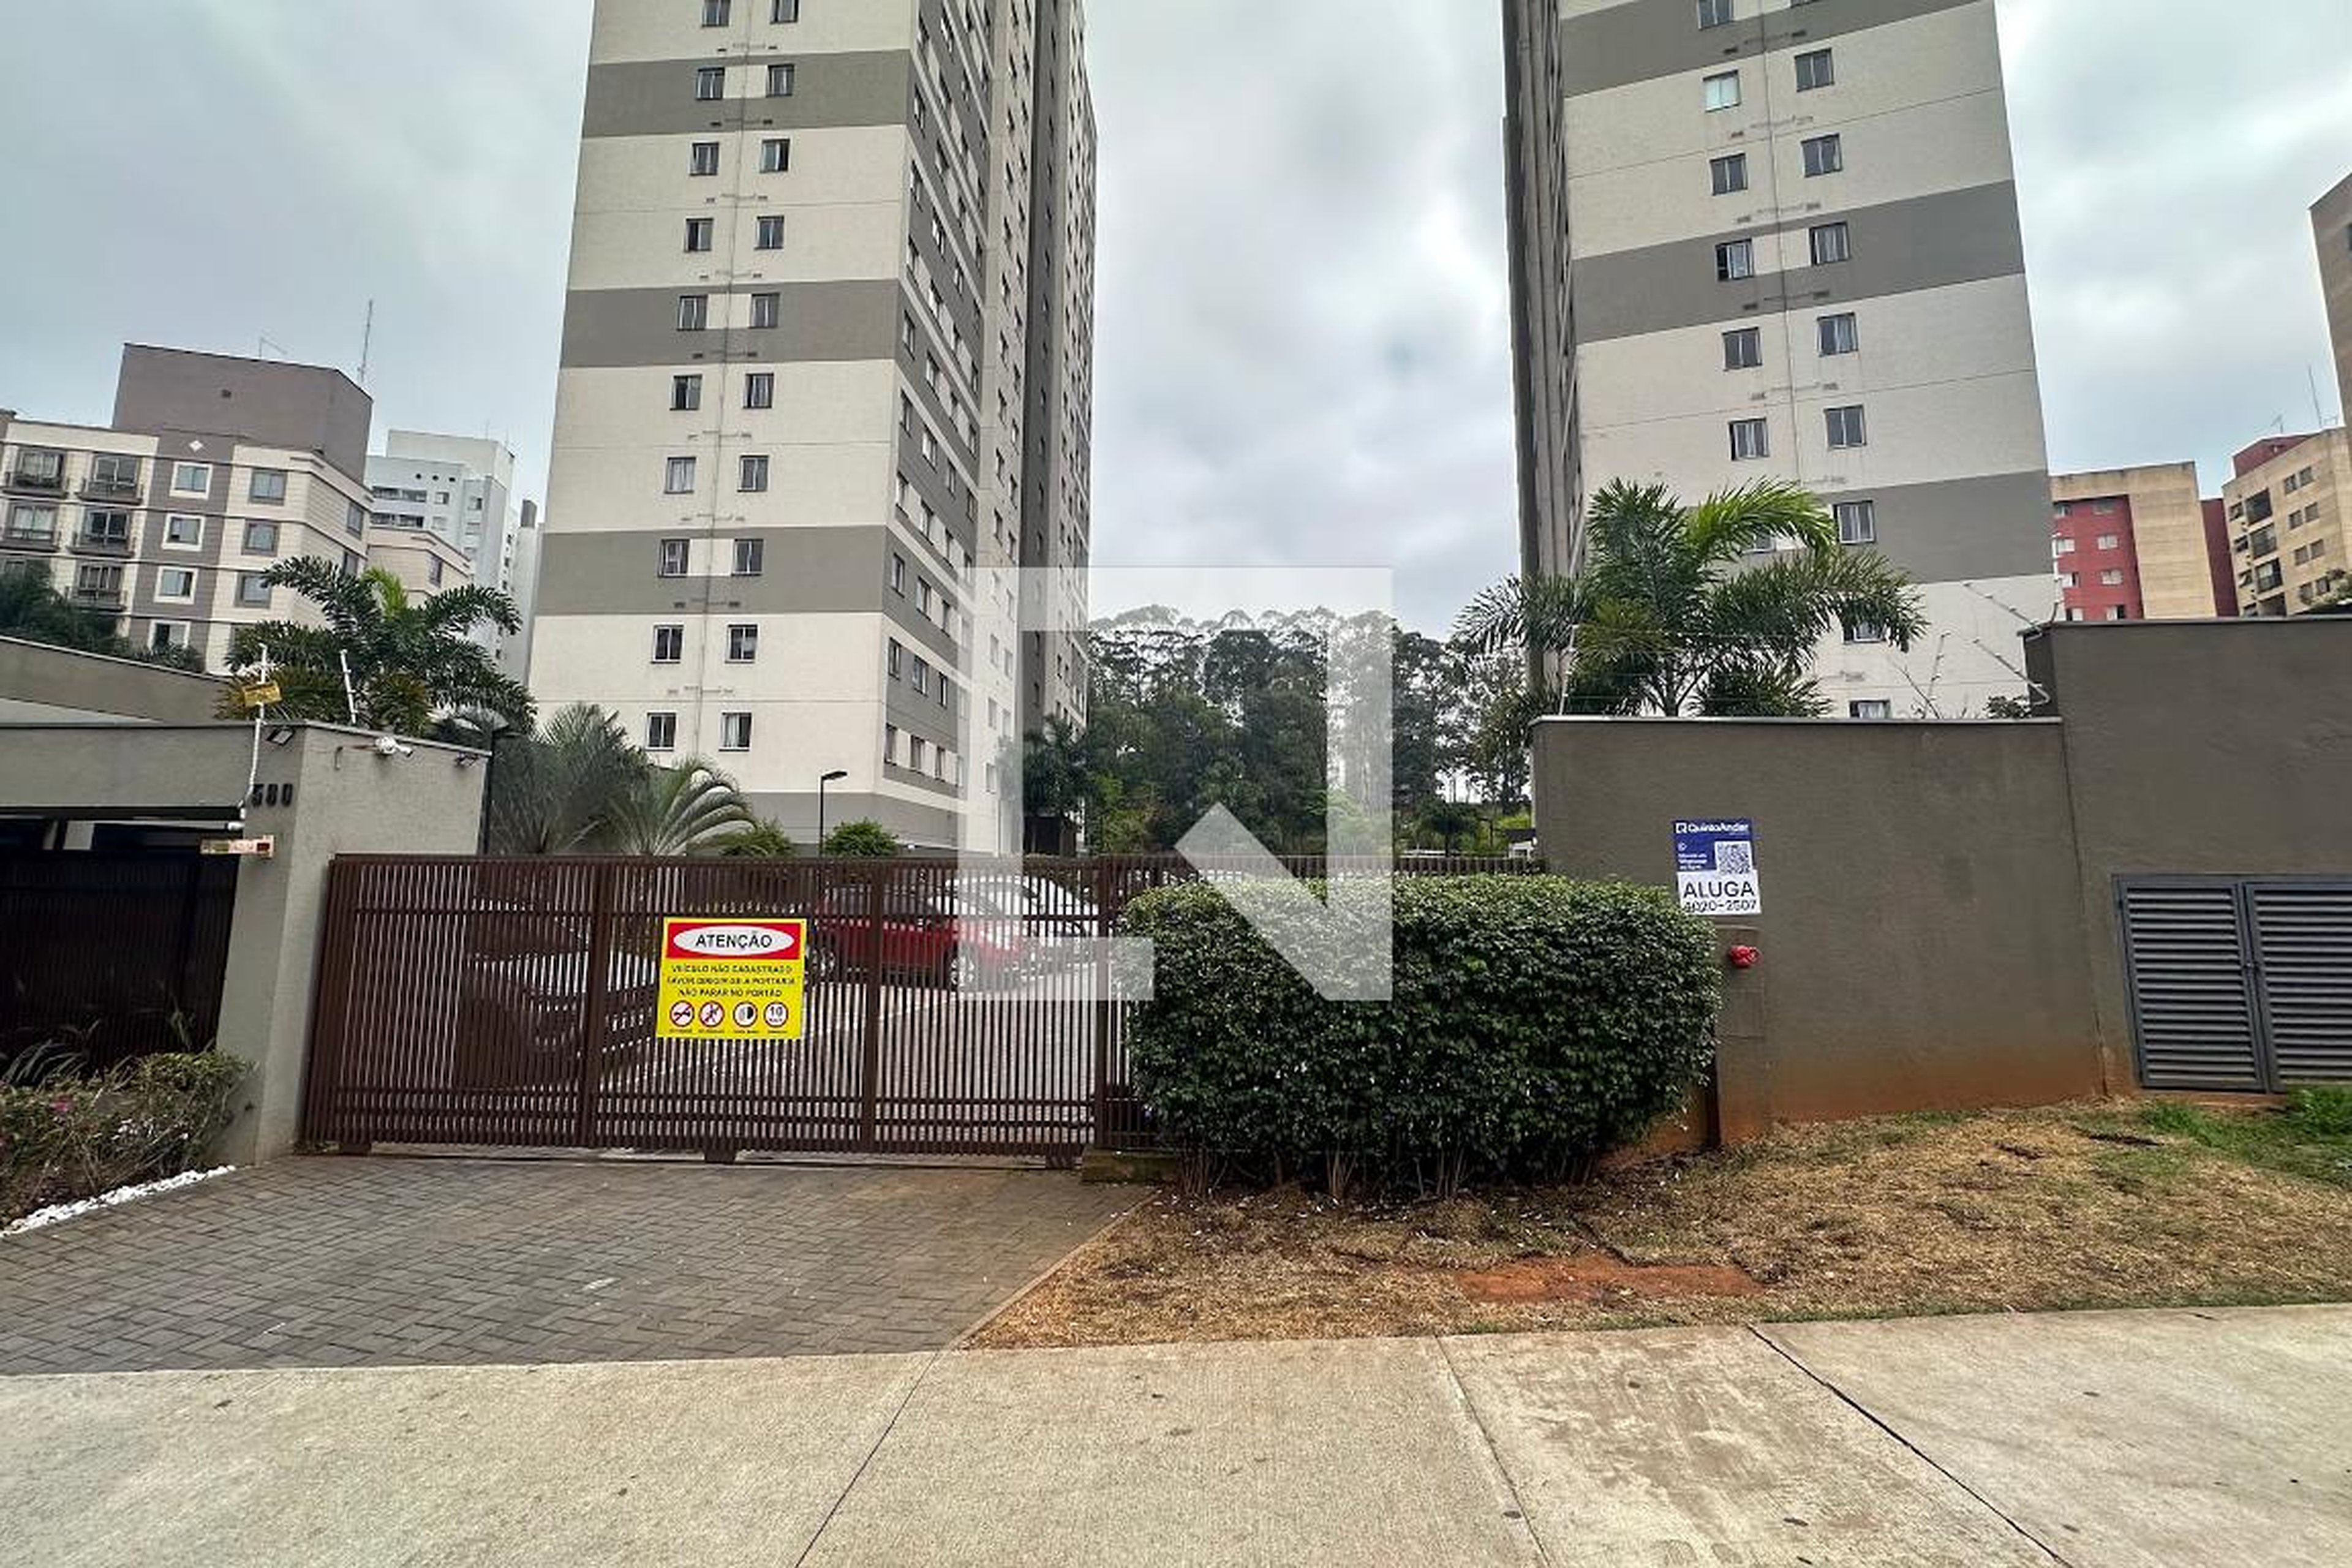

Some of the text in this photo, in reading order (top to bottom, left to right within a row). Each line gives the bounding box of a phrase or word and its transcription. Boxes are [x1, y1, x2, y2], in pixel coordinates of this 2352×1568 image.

[1684, 881, 1754, 898] ALUGA
[695, 930, 772, 949] ATENÇÃO
[770, 1006, 783, 1017] 10
